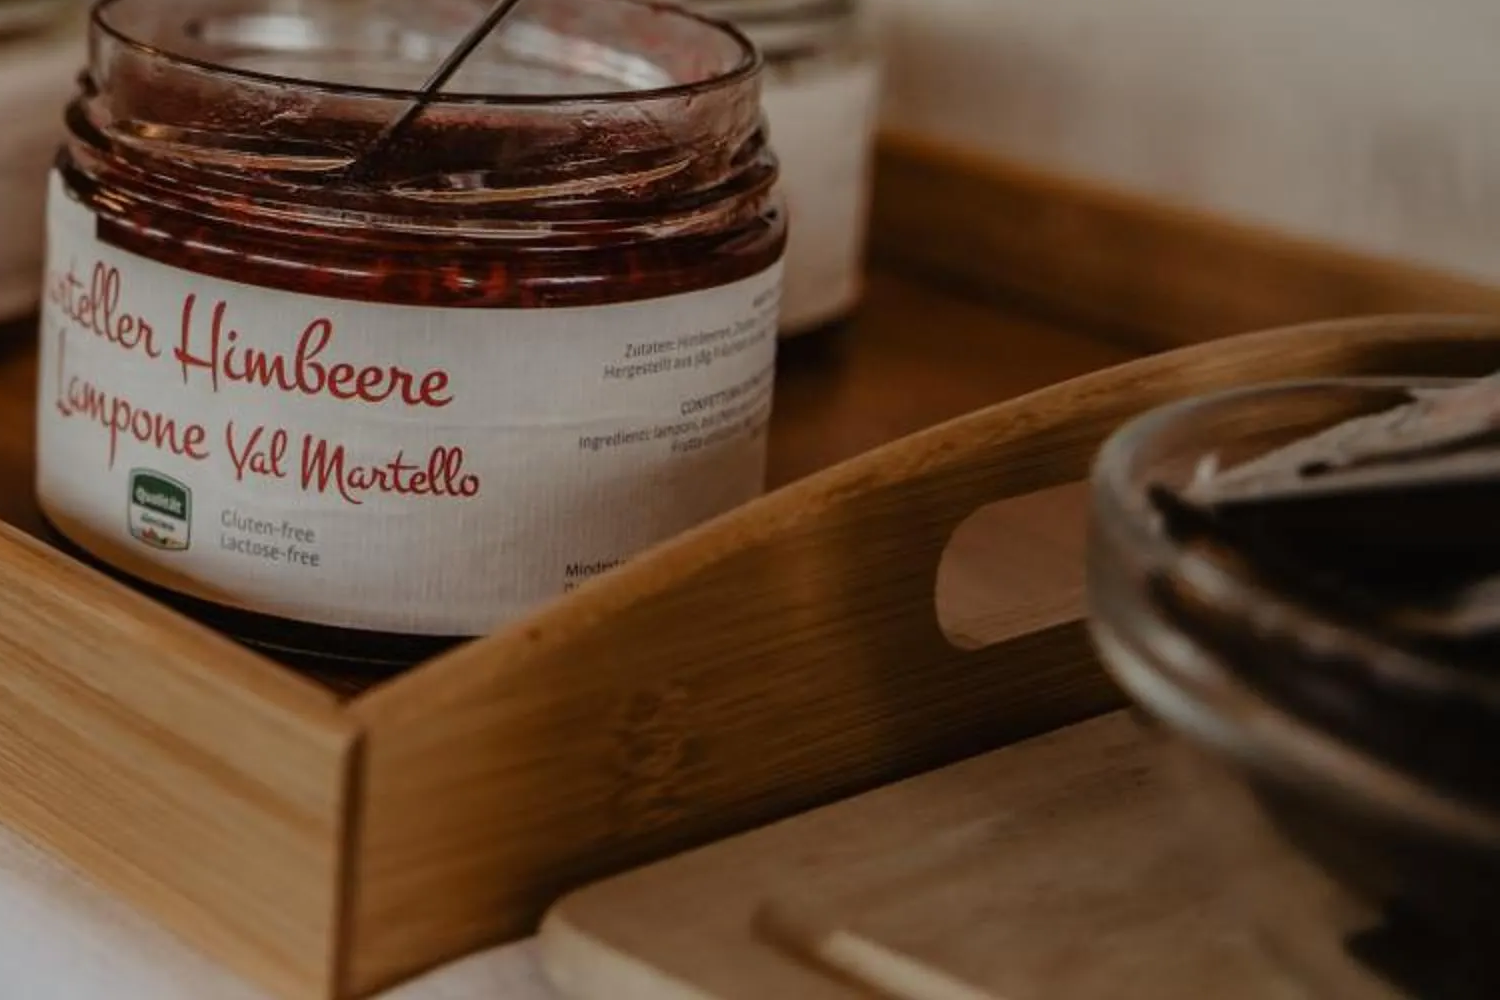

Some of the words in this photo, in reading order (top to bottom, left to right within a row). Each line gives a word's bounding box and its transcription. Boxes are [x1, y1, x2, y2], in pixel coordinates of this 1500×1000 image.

[174, 293, 455, 408] Himbeere
[55, 327, 211, 471] Lampone
[225, 419, 288, 482] Val
[300, 433, 480, 505] Martello
[220, 508, 316, 543] Gluten-free
[220, 534, 321, 567] Lactose-free
